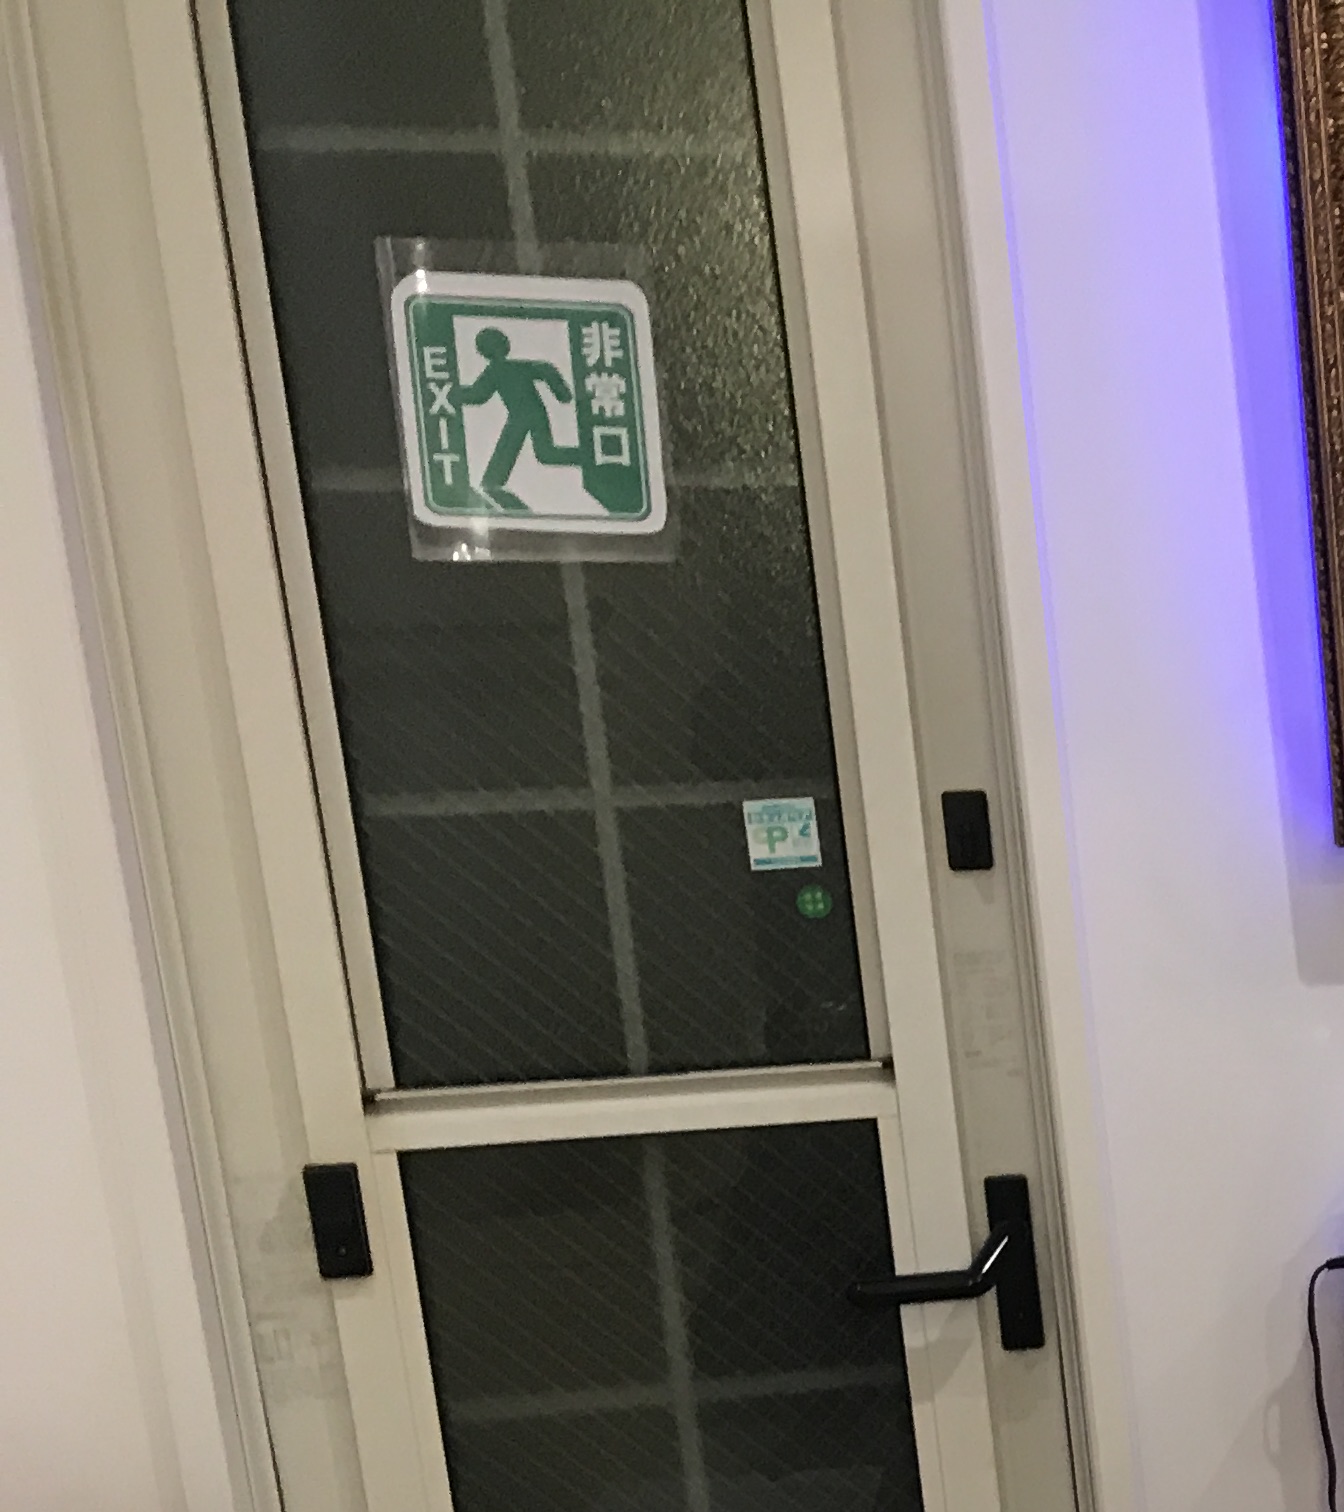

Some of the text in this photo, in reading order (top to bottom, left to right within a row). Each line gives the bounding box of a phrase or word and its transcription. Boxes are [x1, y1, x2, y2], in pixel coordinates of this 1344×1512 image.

[423, 346, 460, 486] EXIT
[581, 320, 631, 467] 非常口
